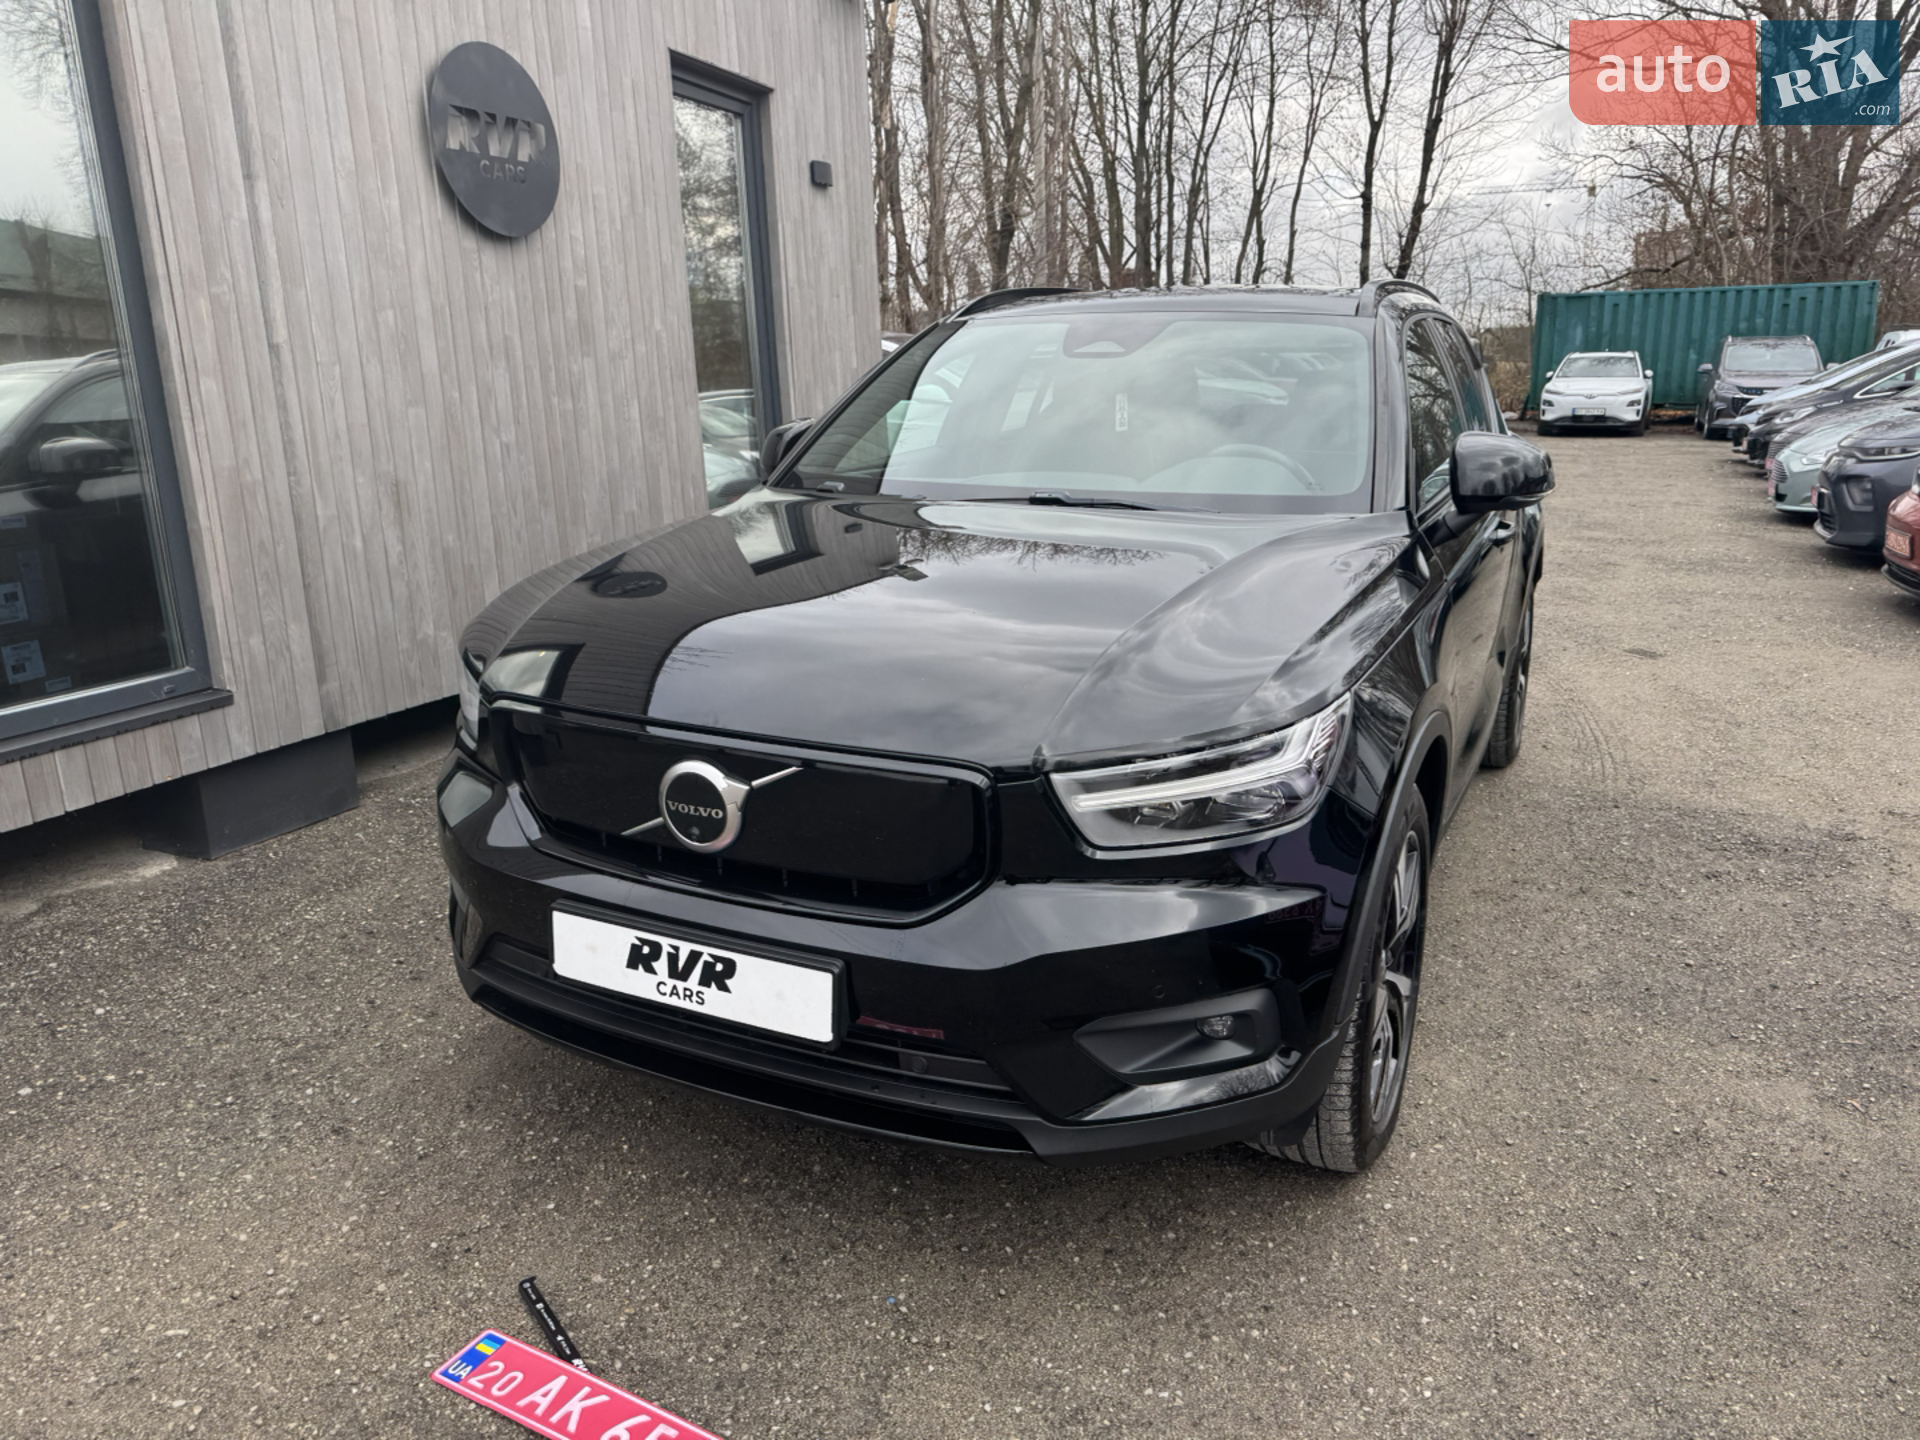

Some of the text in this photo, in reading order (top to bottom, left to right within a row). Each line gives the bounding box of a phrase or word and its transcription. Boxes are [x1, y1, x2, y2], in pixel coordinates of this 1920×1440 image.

[445, 103, 546, 165] RVR
[666, 799, 724, 820] VOLVO
[625, 935, 738, 994] RVR
[655, 980, 706, 1006] CARS
[447, 1359, 473, 1379] UA
[467, 1360, 525, 1397] 20
[515, 1374, 611, 1434] AK
